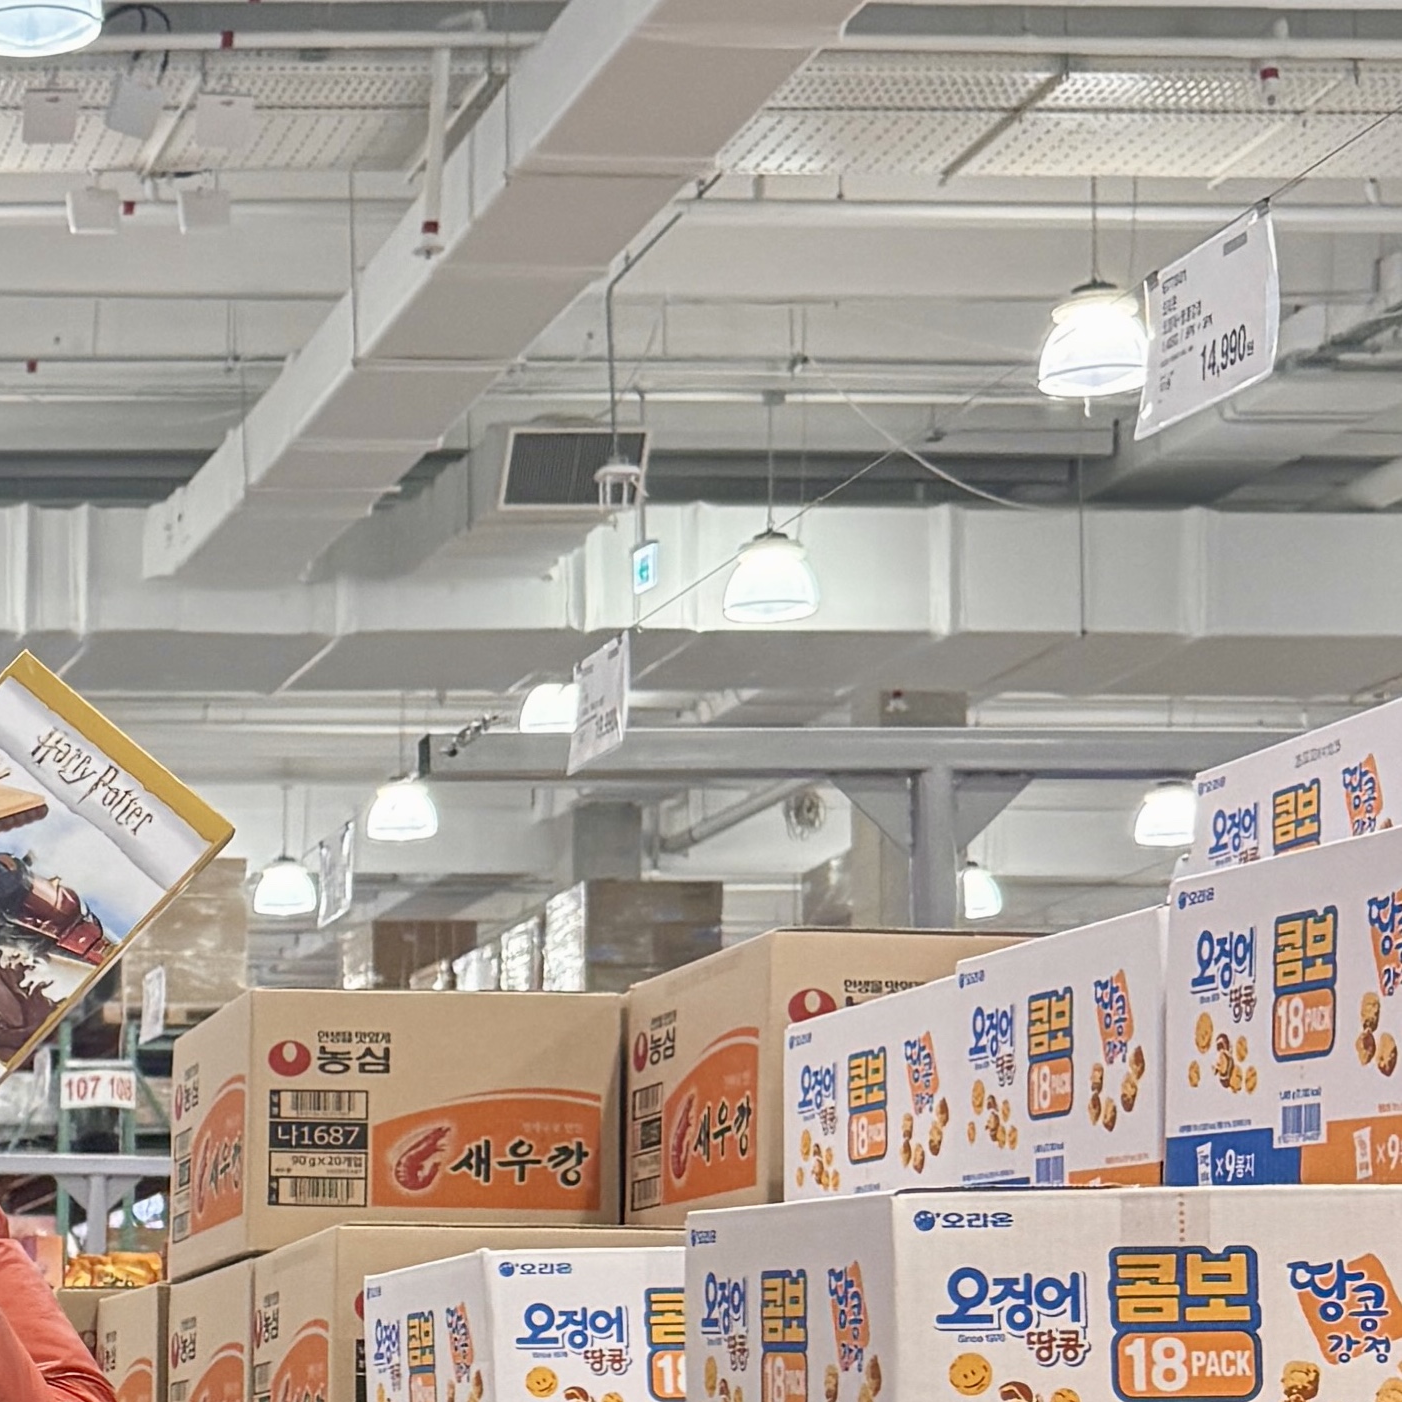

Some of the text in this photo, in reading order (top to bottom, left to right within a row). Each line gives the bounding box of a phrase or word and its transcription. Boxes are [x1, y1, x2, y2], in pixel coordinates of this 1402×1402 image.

[31, 727, 154, 836] Harry Potter
[1208, 801, 1259, 856] 오징어
[1274, 783, 1320, 847] 콤보
[1190, 925, 1258, 994] 오징어
[1275, 911, 1336, 988] 콤보
[968, 1003, 1015, 1058] 오징어
[1029, 990, 1073, 1057] 콤보
[1228, 985, 1258, 1023] 땅콩
[1275, 996, 1333, 1048] 18 PACK
[317, 1046, 391, 1075] 농심
[649, 1027, 677, 1066] 농심
[65, 1078, 98, 1099] 107
[797, 1061, 837, 1111] 오징어
[850, 1049, 886, 1107] 콤보
[1030, 1063, 1051, 1111] 18
[276, 1125, 360, 1147] 나1687
[693, 1091, 753, 1166] 새우깡
[448, 1137, 590, 1188] 새우깡
[937, 1211, 1014, 1230] 오리온
[518, 1262, 573, 1275] 오리온
[1115, 1252, 1252, 1323] 콤보
[1287, 1258, 1392, 1331] 땅콩
[515, 1302, 628, 1351] 오징어
[702, 1271, 748, 1336] 오징어
[762, 1274, 806, 1343] 콤보
[934, 1266, 1087, 1334] 오징어
[584, 1347, 632, 1376] 땅콩
[1026, 1329, 1091, 1367] 땅콩
[1123, 1337, 1253, 1393] 18 PACK
[1326, 1334, 1392, 1363] 강정
